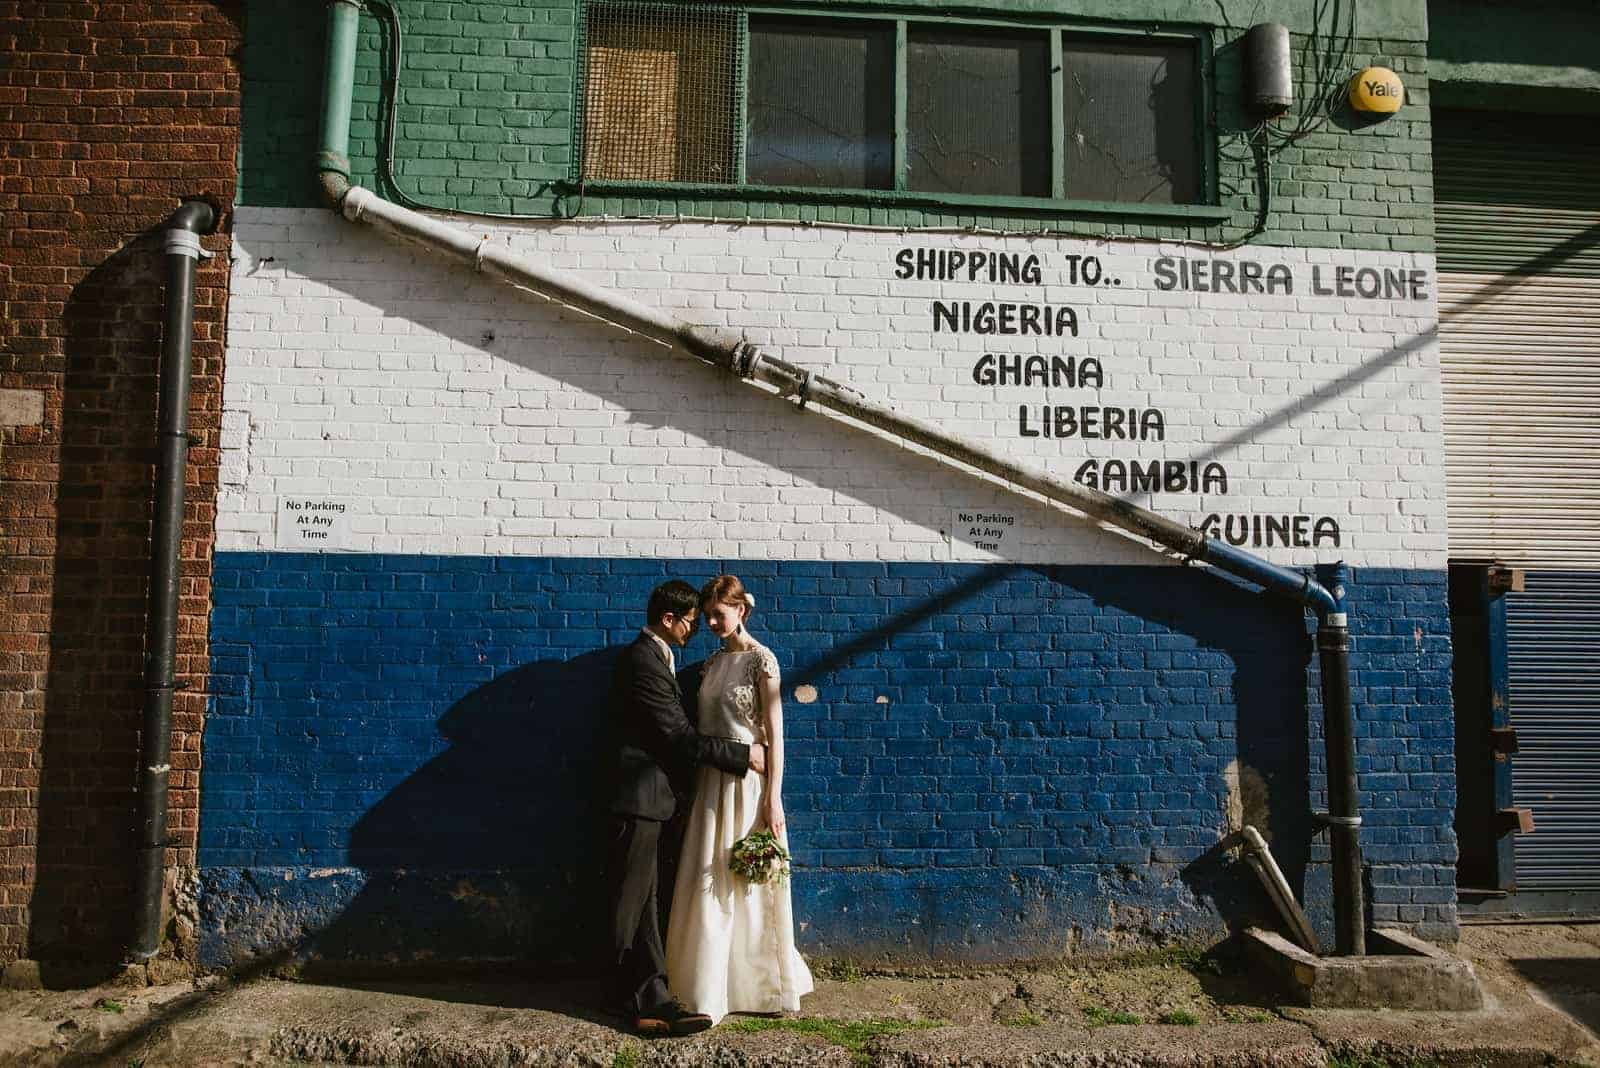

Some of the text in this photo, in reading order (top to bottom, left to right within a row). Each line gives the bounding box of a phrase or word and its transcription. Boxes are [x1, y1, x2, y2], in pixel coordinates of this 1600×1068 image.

[1365, 81, 1398, 97] Yale
[895, 248, 1042, 285] SHIPPING
[1154, 257, 1293, 295] SIERRA
[1313, 265, 1428, 301] LEONE
[932, 301, 1078, 337] NIGERIA
[972, 354, 1104, 388] GHANA
[1019, 405, 1165, 441] LIBERIA
[1074, 459, 1228, 494] GAMBIA
[286, 500, 345, 513] No Parking
[296, 515, 334, 527] At Any
[958, 513, 1014, 525] No Parking
[300, 529, 328, 539] Time
[969, 527, 1003, 539] At Any
[1201, 513, 1341, 548] GUINEA
[973, 540, 998, 550] Time
